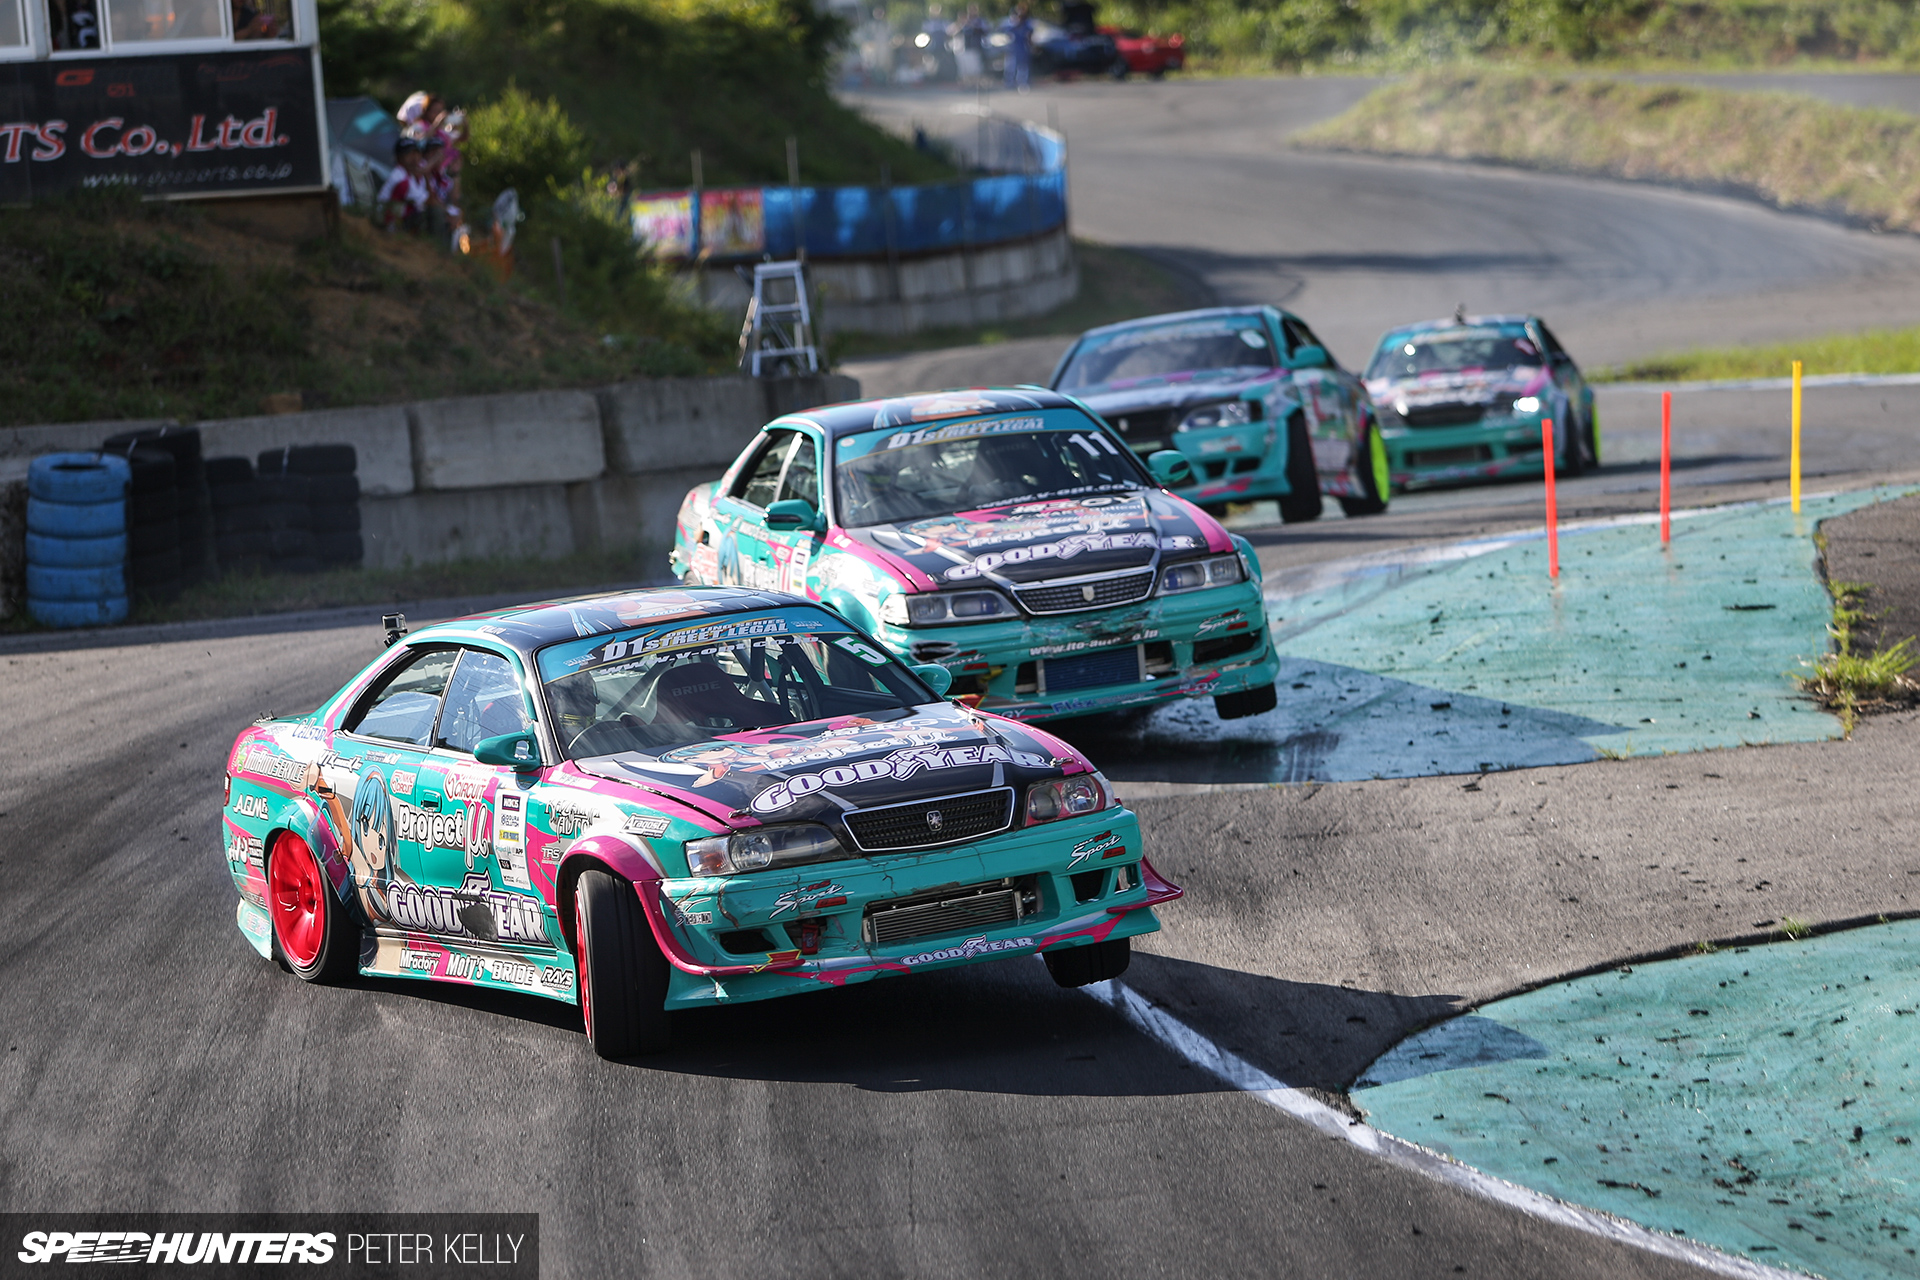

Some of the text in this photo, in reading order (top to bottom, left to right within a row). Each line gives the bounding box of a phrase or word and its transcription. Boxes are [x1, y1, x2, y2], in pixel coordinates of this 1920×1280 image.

[1068, 431, 1118, 456] 11
[944, 531, 1197, 581] GOODYEAR
[727, 622, 790, 638] LEGAL
[832, 636, 887, 664] 5
[671, 681, 721, 697] BRIDE
[454, 781, 487, 800] CIRCUIT
[749, 743, 1052, 813] GOODYEAR
[622, 814, 669, 832] Aragosta
[541, 847, 560, 860] TRS
[1066, 835, 1121, 870] Sport
[768, 884, 844, 919] Sport
[899, 934, 1037, 967] GOODYEAR
[446, 952, 485, 980] Moty's
[492, 961, 535, 986] BRIDE
[541, 967, 574, 987] RAYS
